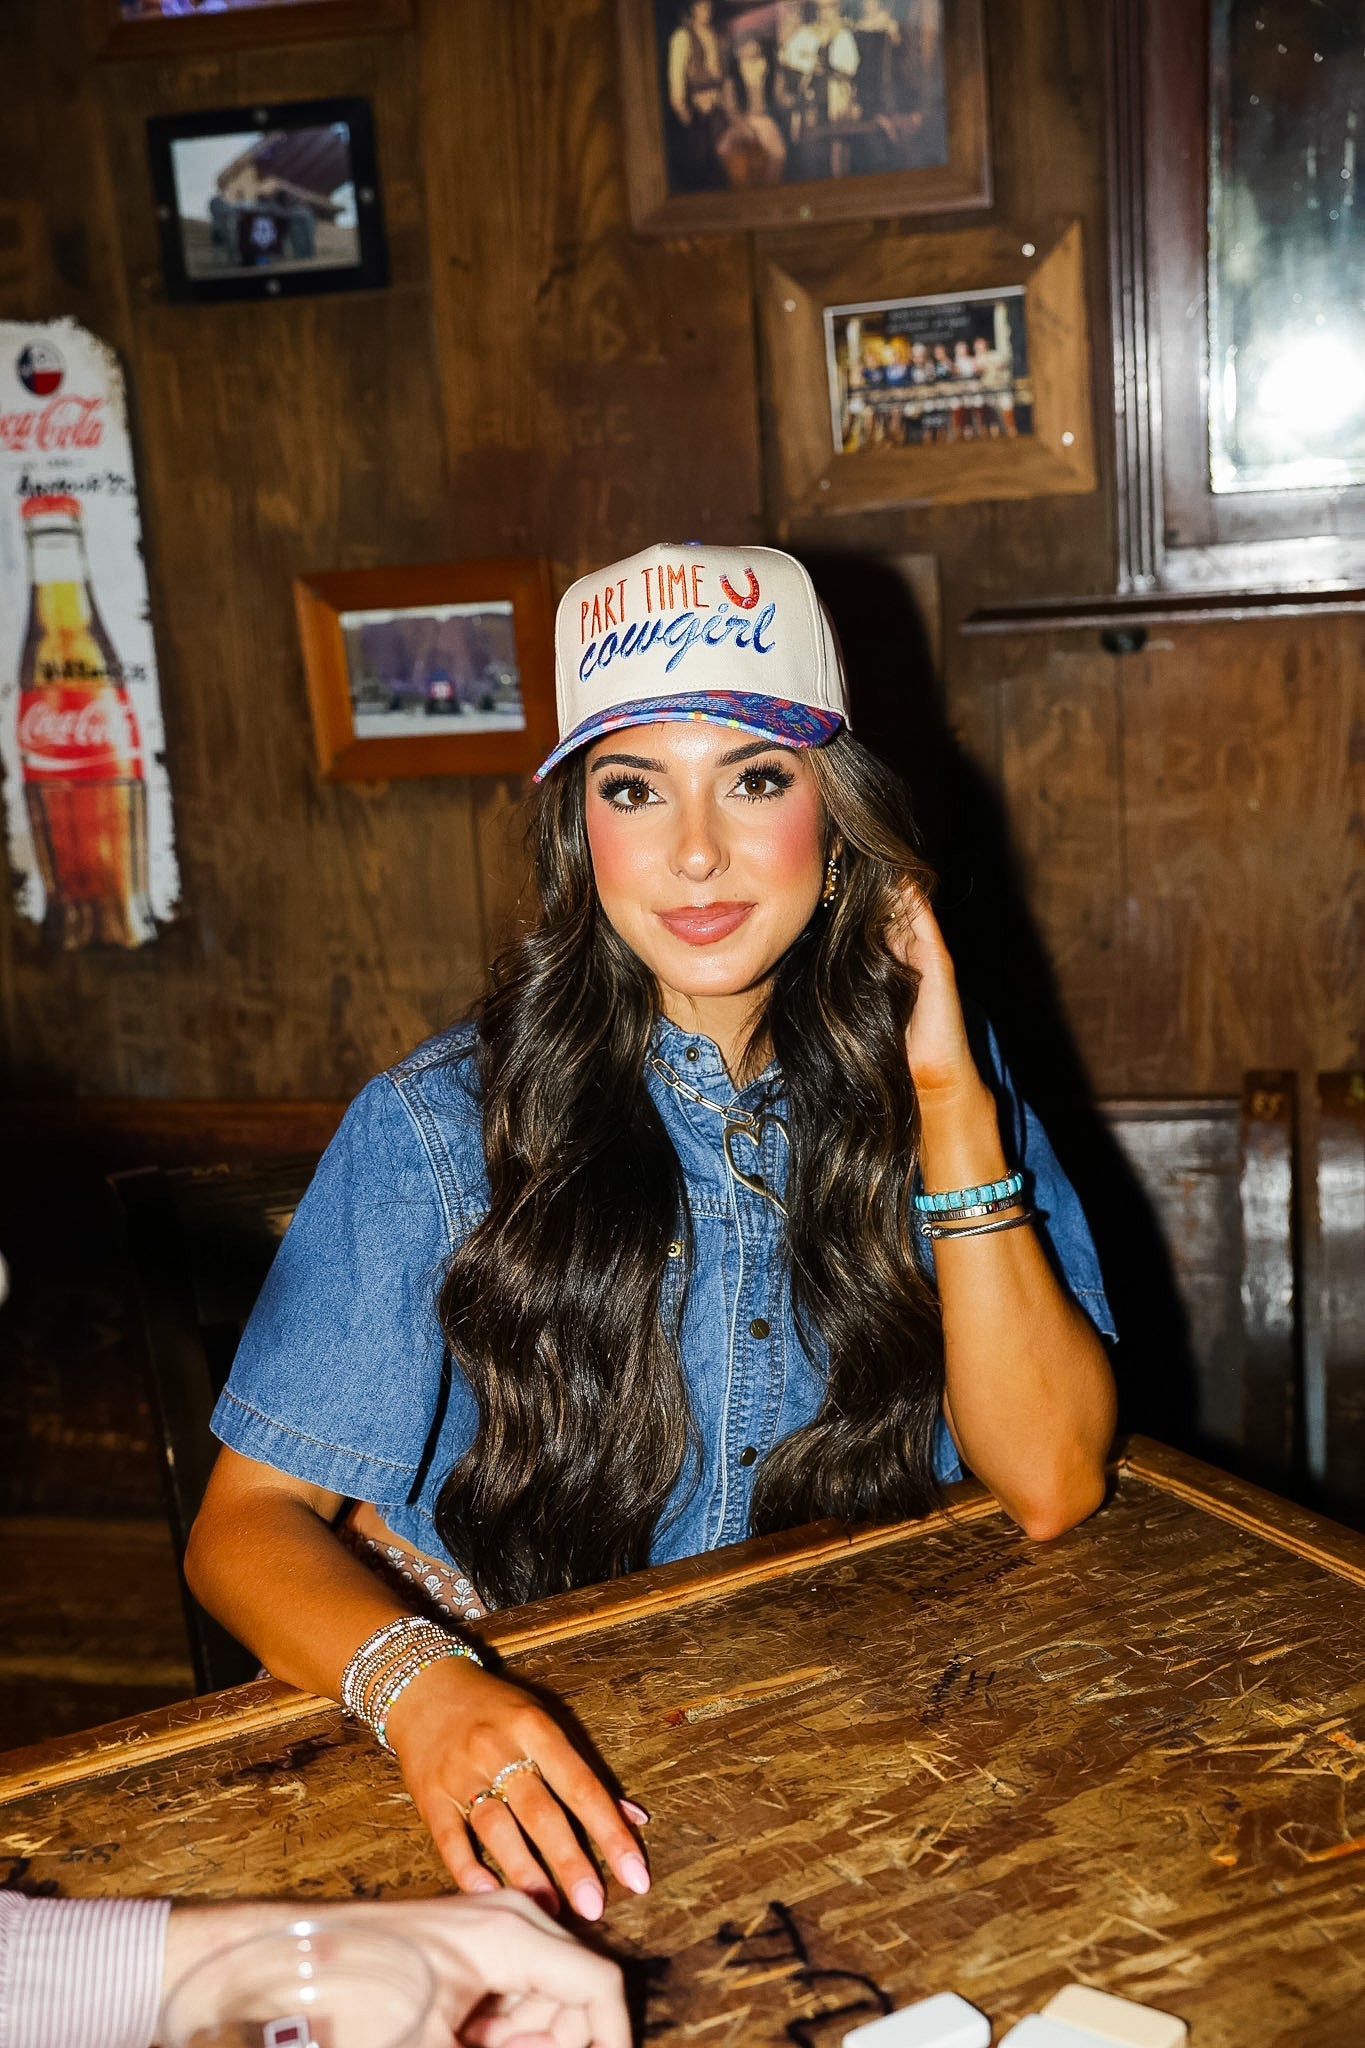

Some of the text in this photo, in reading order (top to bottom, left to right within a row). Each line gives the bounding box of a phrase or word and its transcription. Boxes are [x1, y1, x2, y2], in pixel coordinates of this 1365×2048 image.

[578, 602, 776, 683] cowgirl
[580, 563, 710, 645] PART TIME
